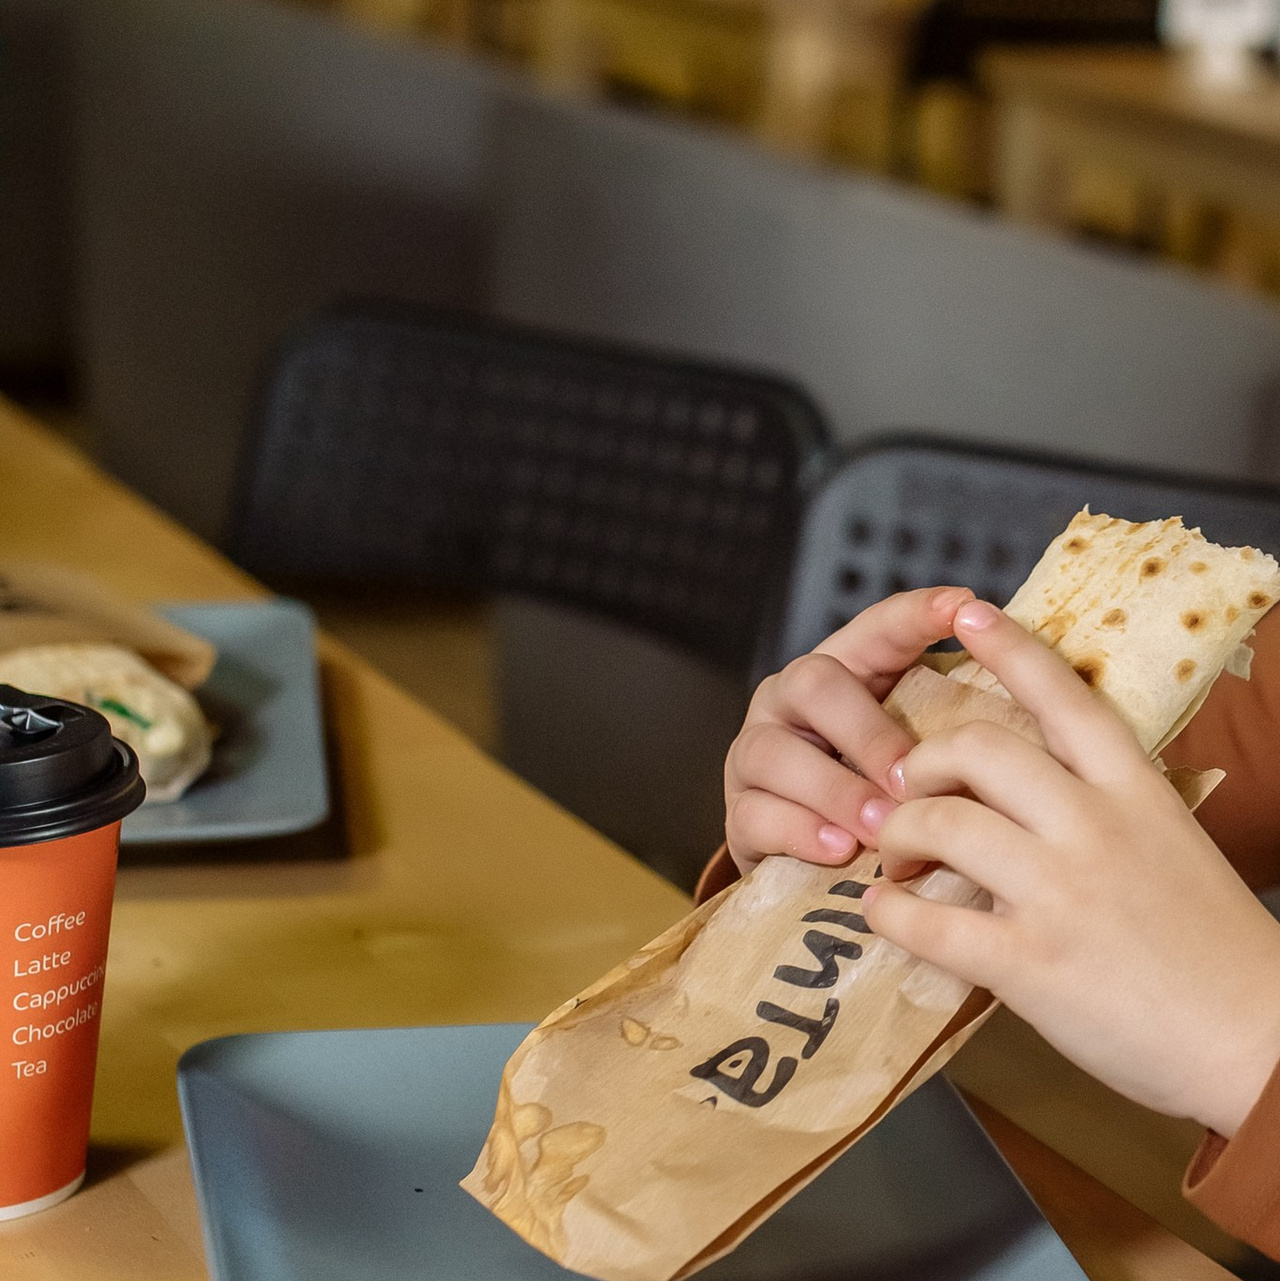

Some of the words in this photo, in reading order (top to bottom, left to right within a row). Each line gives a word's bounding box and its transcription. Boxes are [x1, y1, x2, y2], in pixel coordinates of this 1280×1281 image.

[14, 910, 87, 942] Coffee
[13, 950, 72, 977] Latte
[12, 1001, 99, 1046] Chocolate
[11, 1059, 48, 1080] Tea
